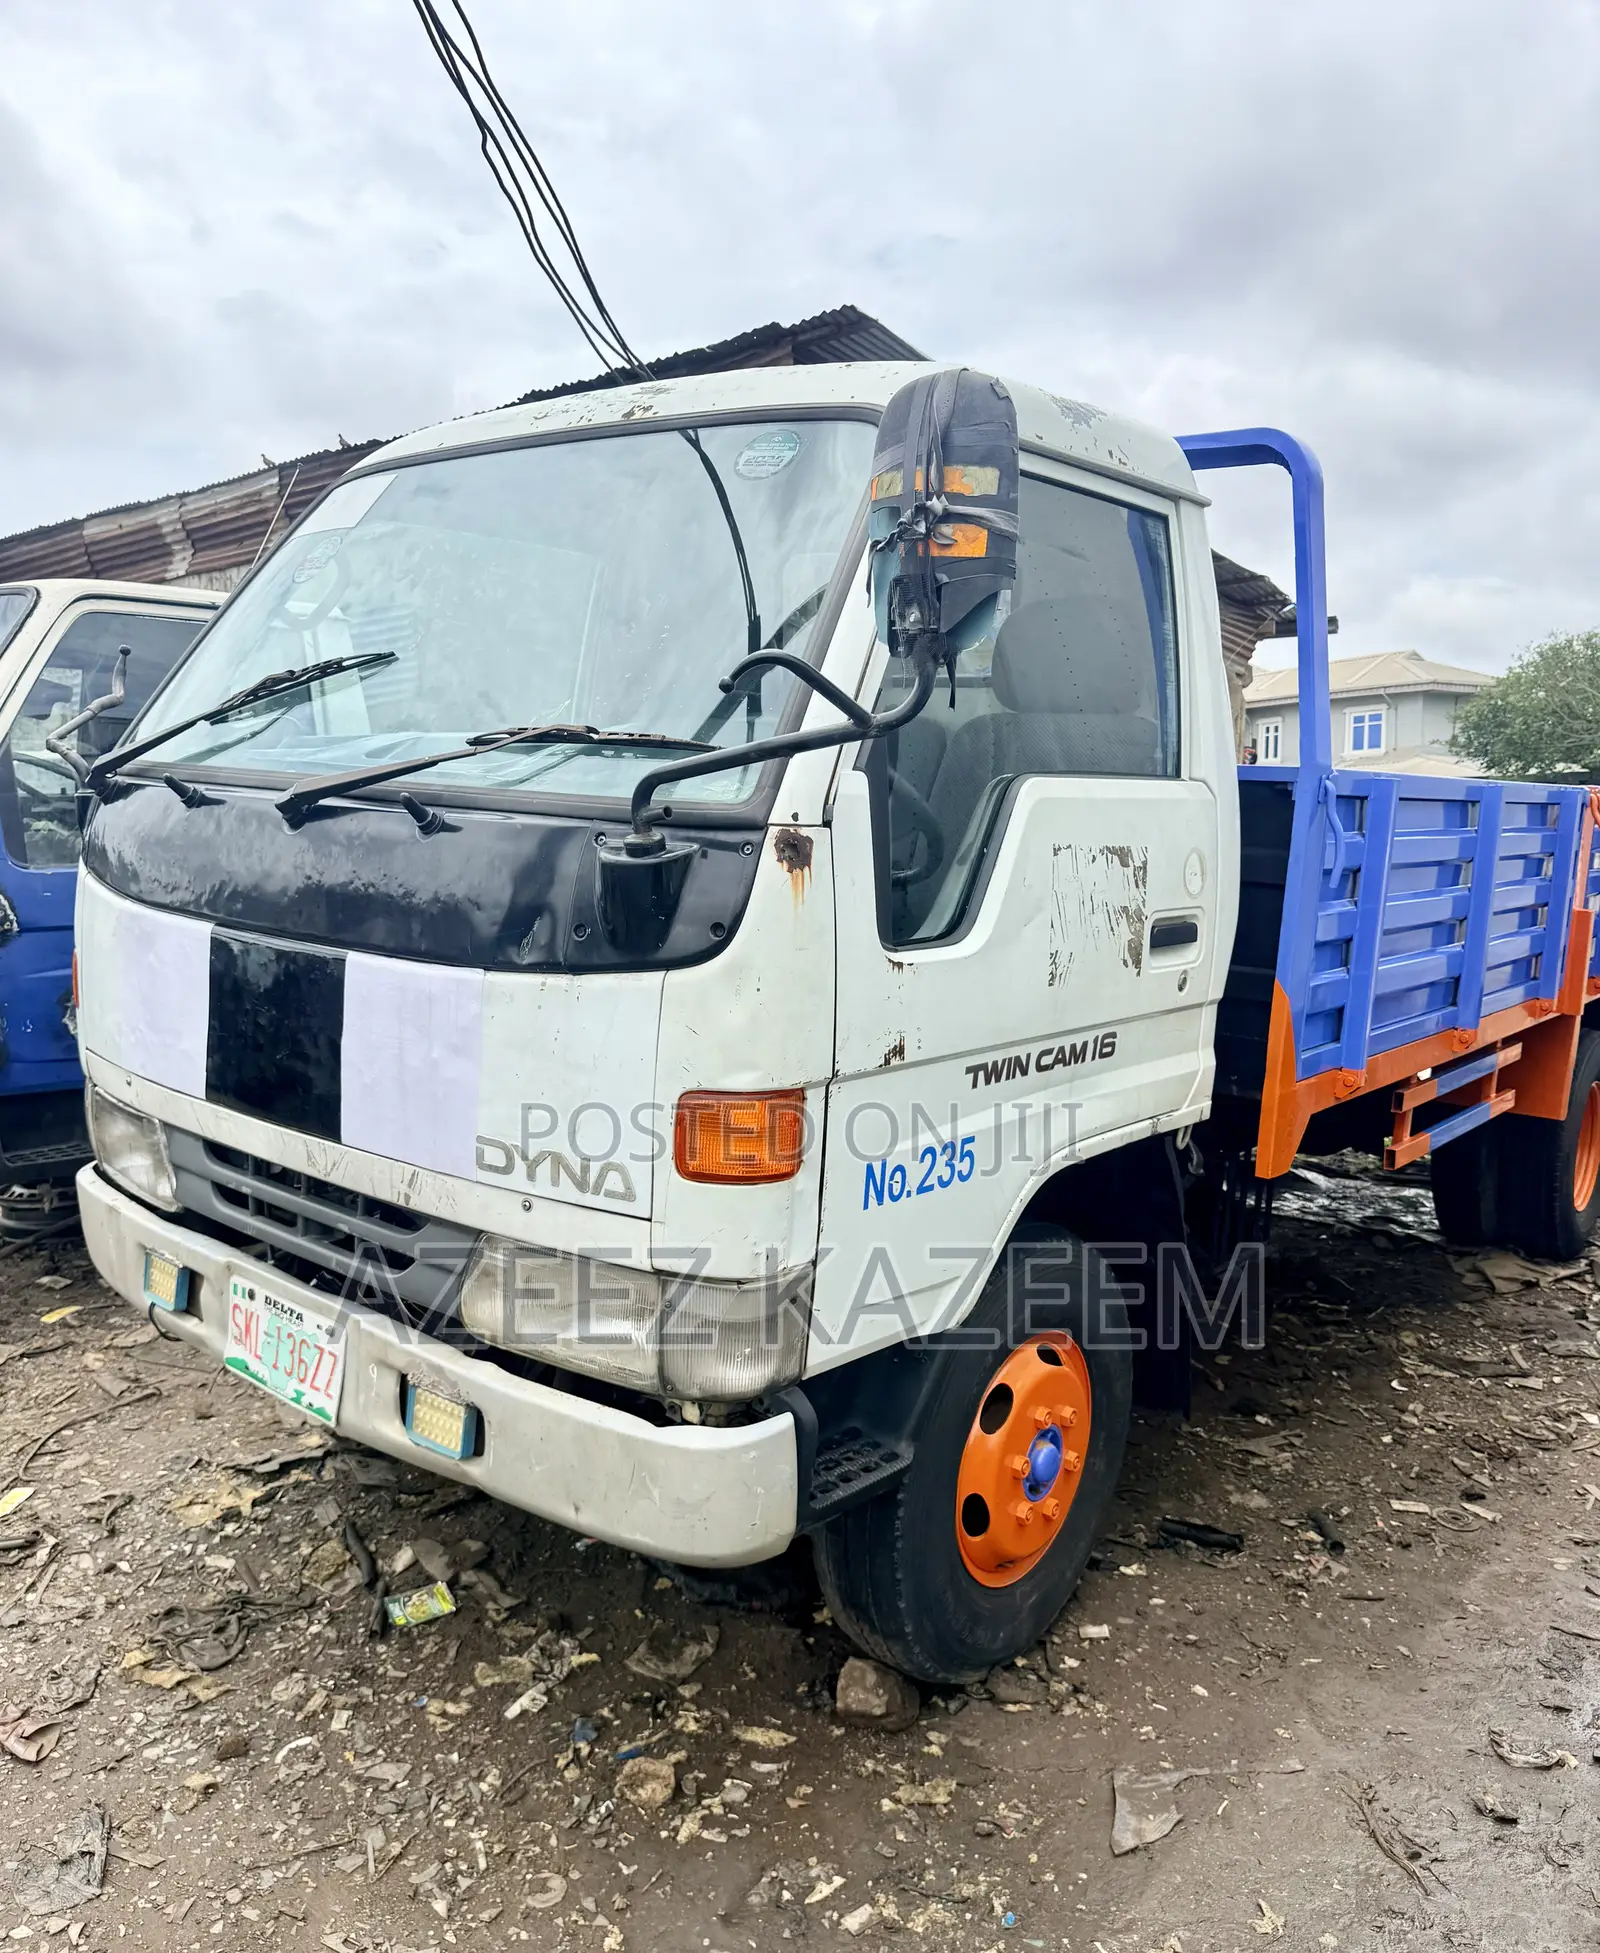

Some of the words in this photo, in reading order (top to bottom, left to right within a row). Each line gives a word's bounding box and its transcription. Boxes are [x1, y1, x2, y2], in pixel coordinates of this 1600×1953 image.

[964, 1052, 1032, 1090] TWIN
[1035, 1039, 1089, 1073] CAM
[475, 1134, 637, 1203] DYNA
[264, 1294, 304, 1322] DELTA
